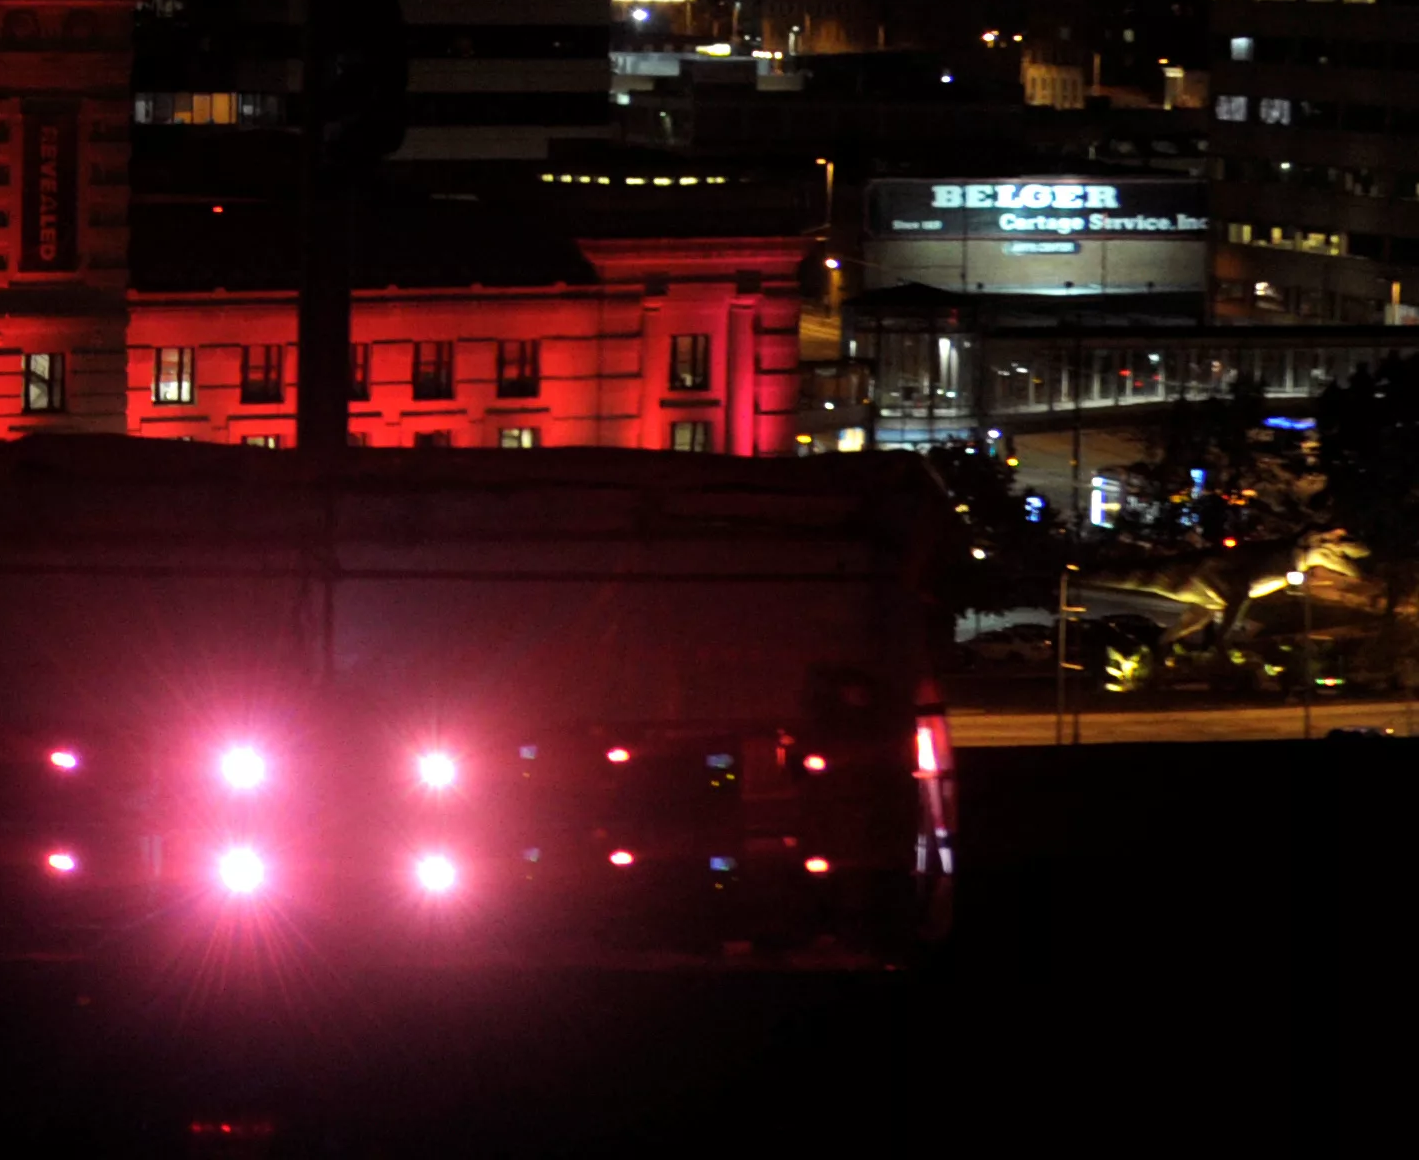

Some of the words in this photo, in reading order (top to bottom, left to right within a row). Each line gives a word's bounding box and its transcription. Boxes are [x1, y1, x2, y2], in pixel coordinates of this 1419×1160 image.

[39, 125, 58, 262] REVEALED
[932, 184, 1120, 208] BELGER
[999, 214, 1085, 234] Cartage
